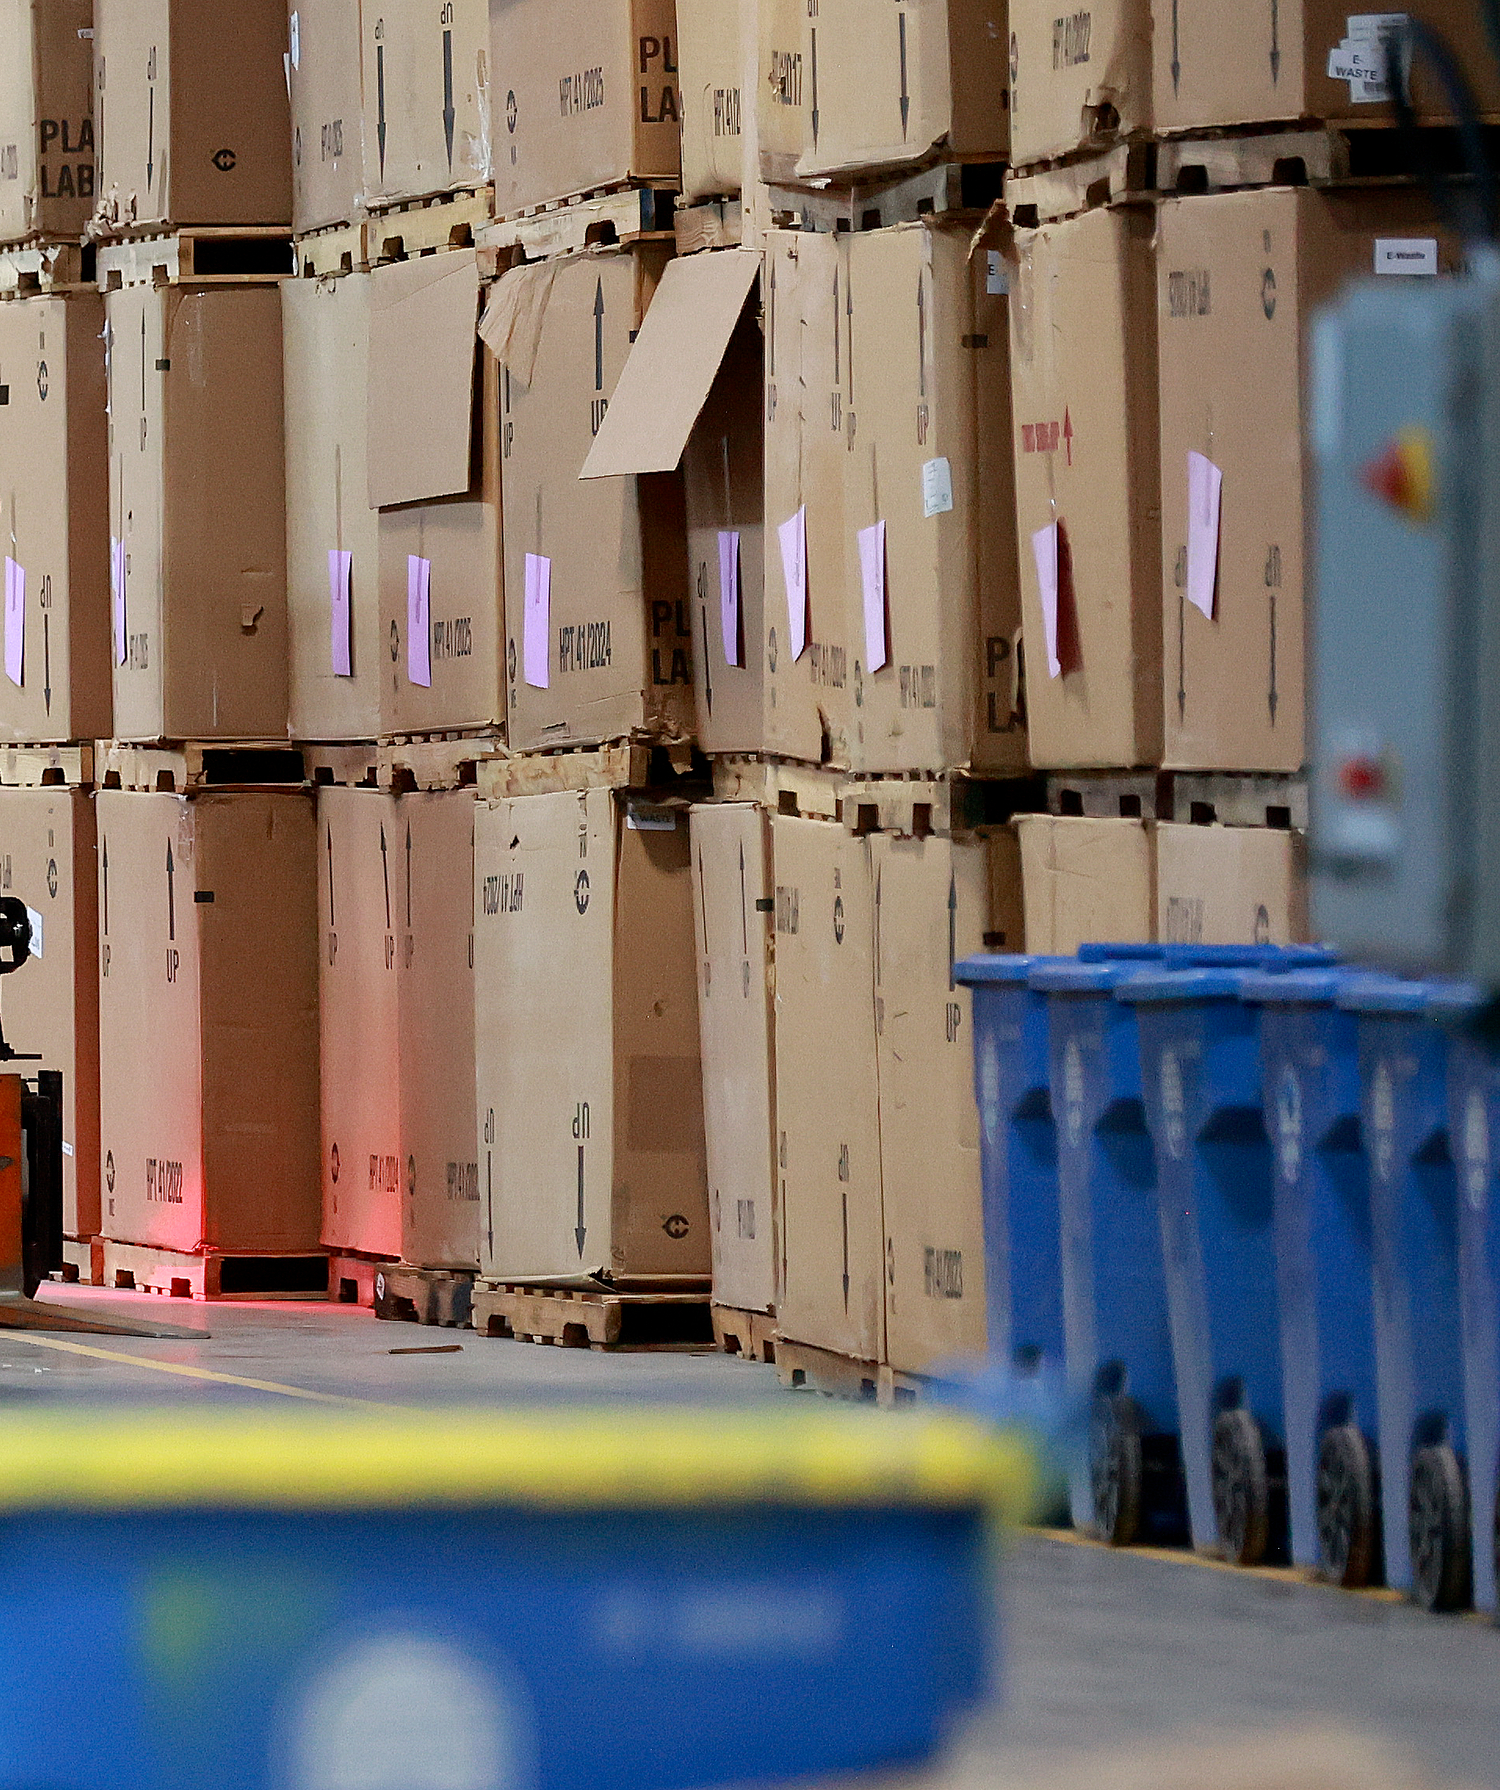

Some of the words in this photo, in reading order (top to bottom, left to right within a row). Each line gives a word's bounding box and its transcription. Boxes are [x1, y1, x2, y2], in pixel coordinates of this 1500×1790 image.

[440, 2, 453, 25] UP
[639, 36, 677, 74] PL
[1335, 66, 1378, 80] WASTE
[640, 86, 677, 123] LA
[41, 164, 94, 198] LAB
[504, 422, 513, 459] UP
[40, 575, 52, 608] UP
[559, 627, 574, 673] HPT
[576, 620, 612, 671] 41/2024
[167, 949, 179, 983] UP
[946, 1003, 961, 1042] UP
[484, 1108, 494, 1144] UP
[572, 1102, 589, 1139] UP
